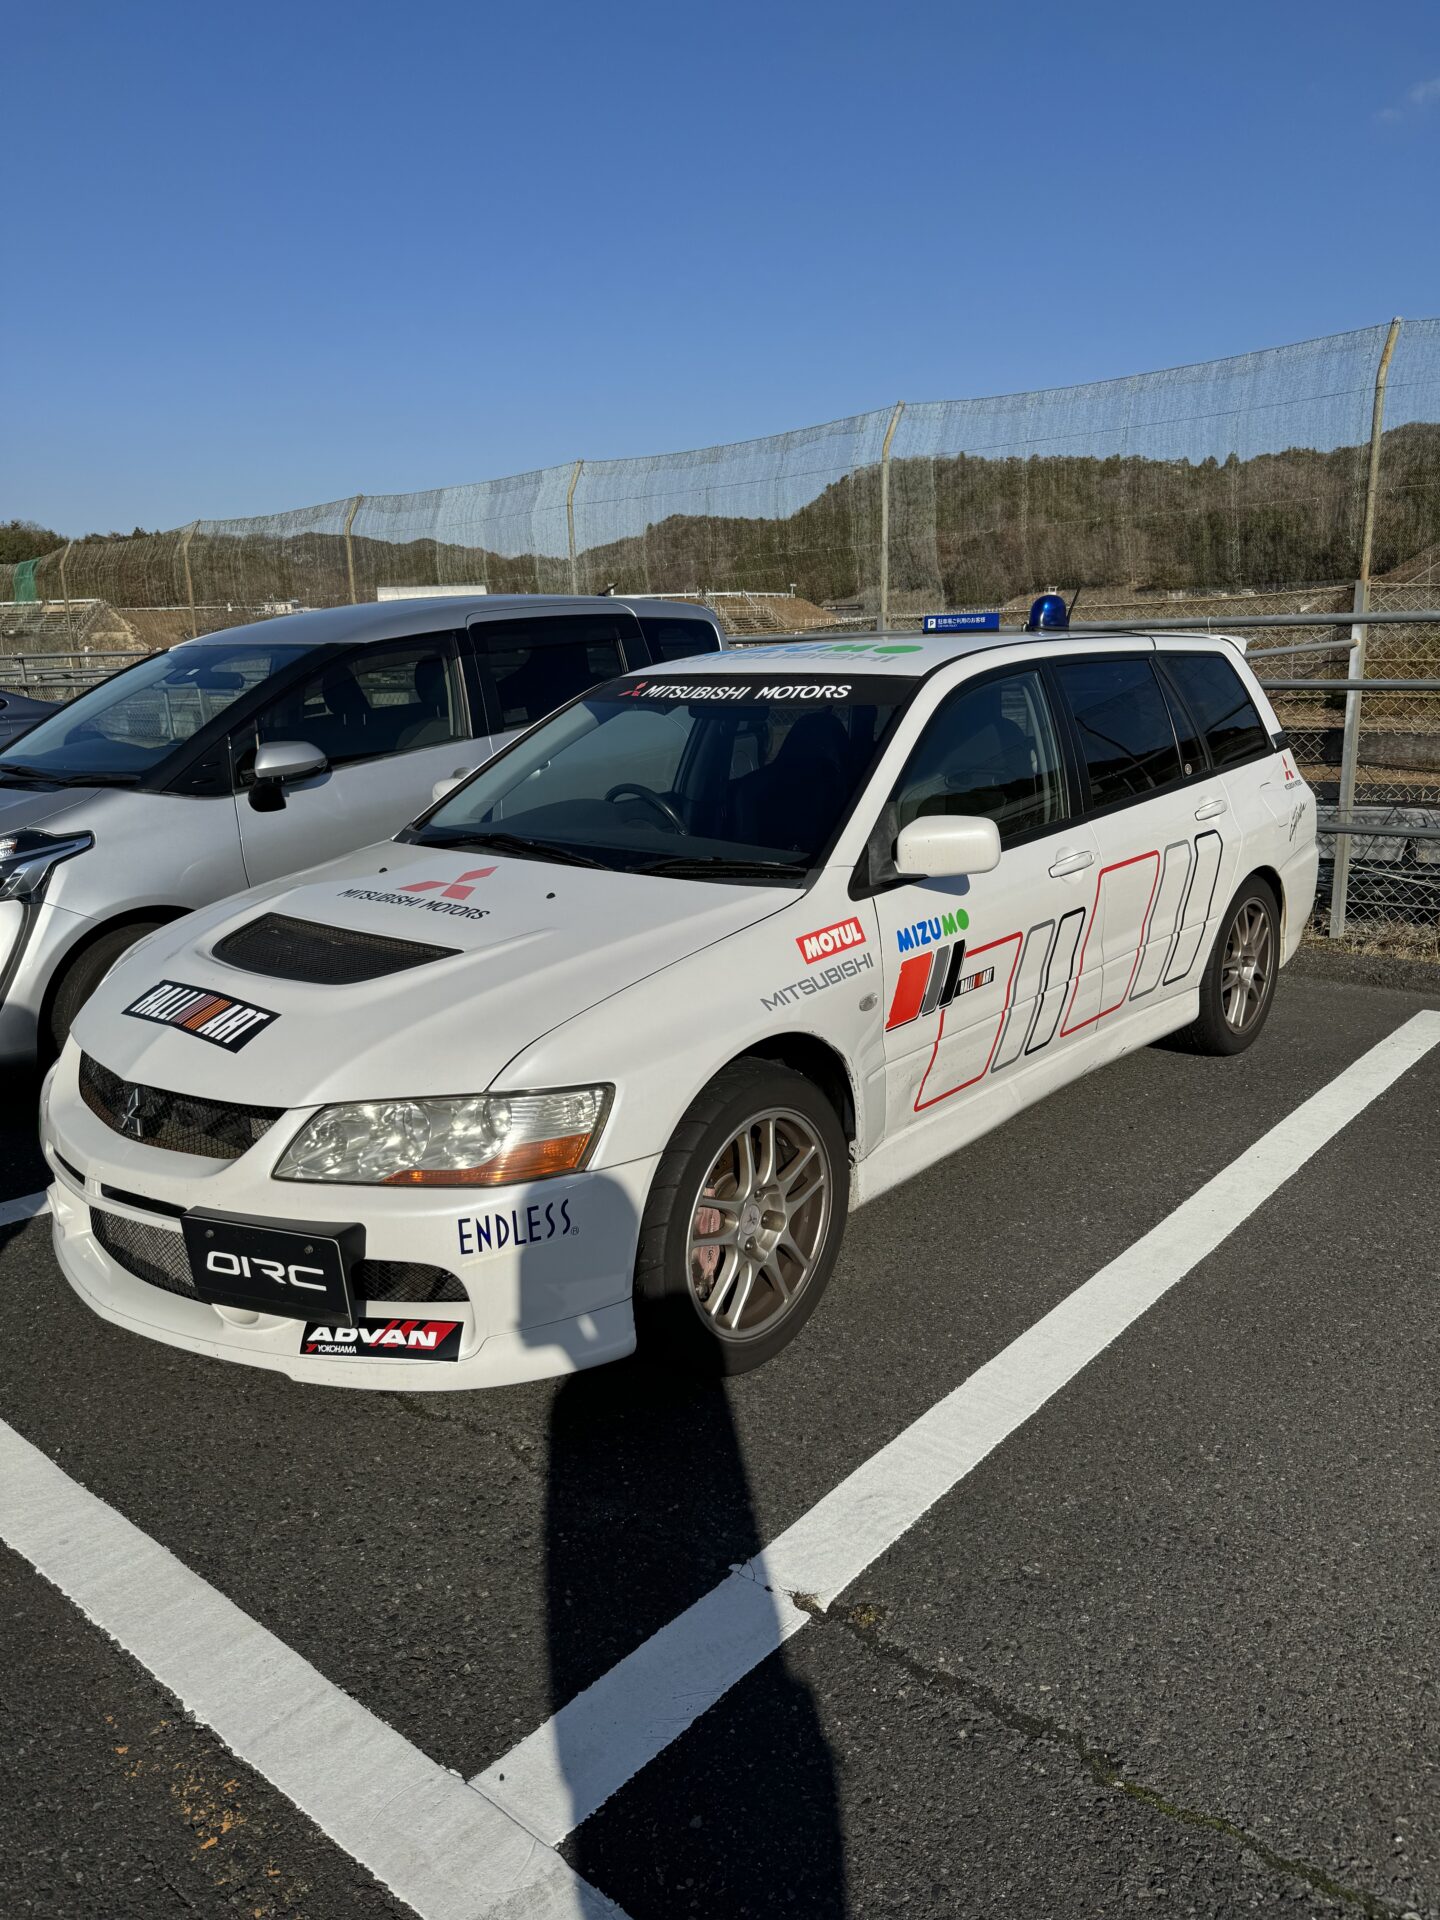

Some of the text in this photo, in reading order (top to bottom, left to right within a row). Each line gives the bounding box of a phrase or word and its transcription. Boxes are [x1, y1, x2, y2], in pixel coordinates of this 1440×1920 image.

[641, 685, 852, 699] MITSUBISHI MOTORS
[337, 888, 490, 920] MITSUBISHI MOTORS
[803, 922, 862, 959] MOTUL
[897, 908, 970, 952] MIZUMO
[760, 952, 874, 1011] MITSUBISHI
[206, 1250, 327, 1291] OIRC
[307, 1326, 438, 1347] ADVAN
[317, 1344, 357, 1354] YOKOHAMA
